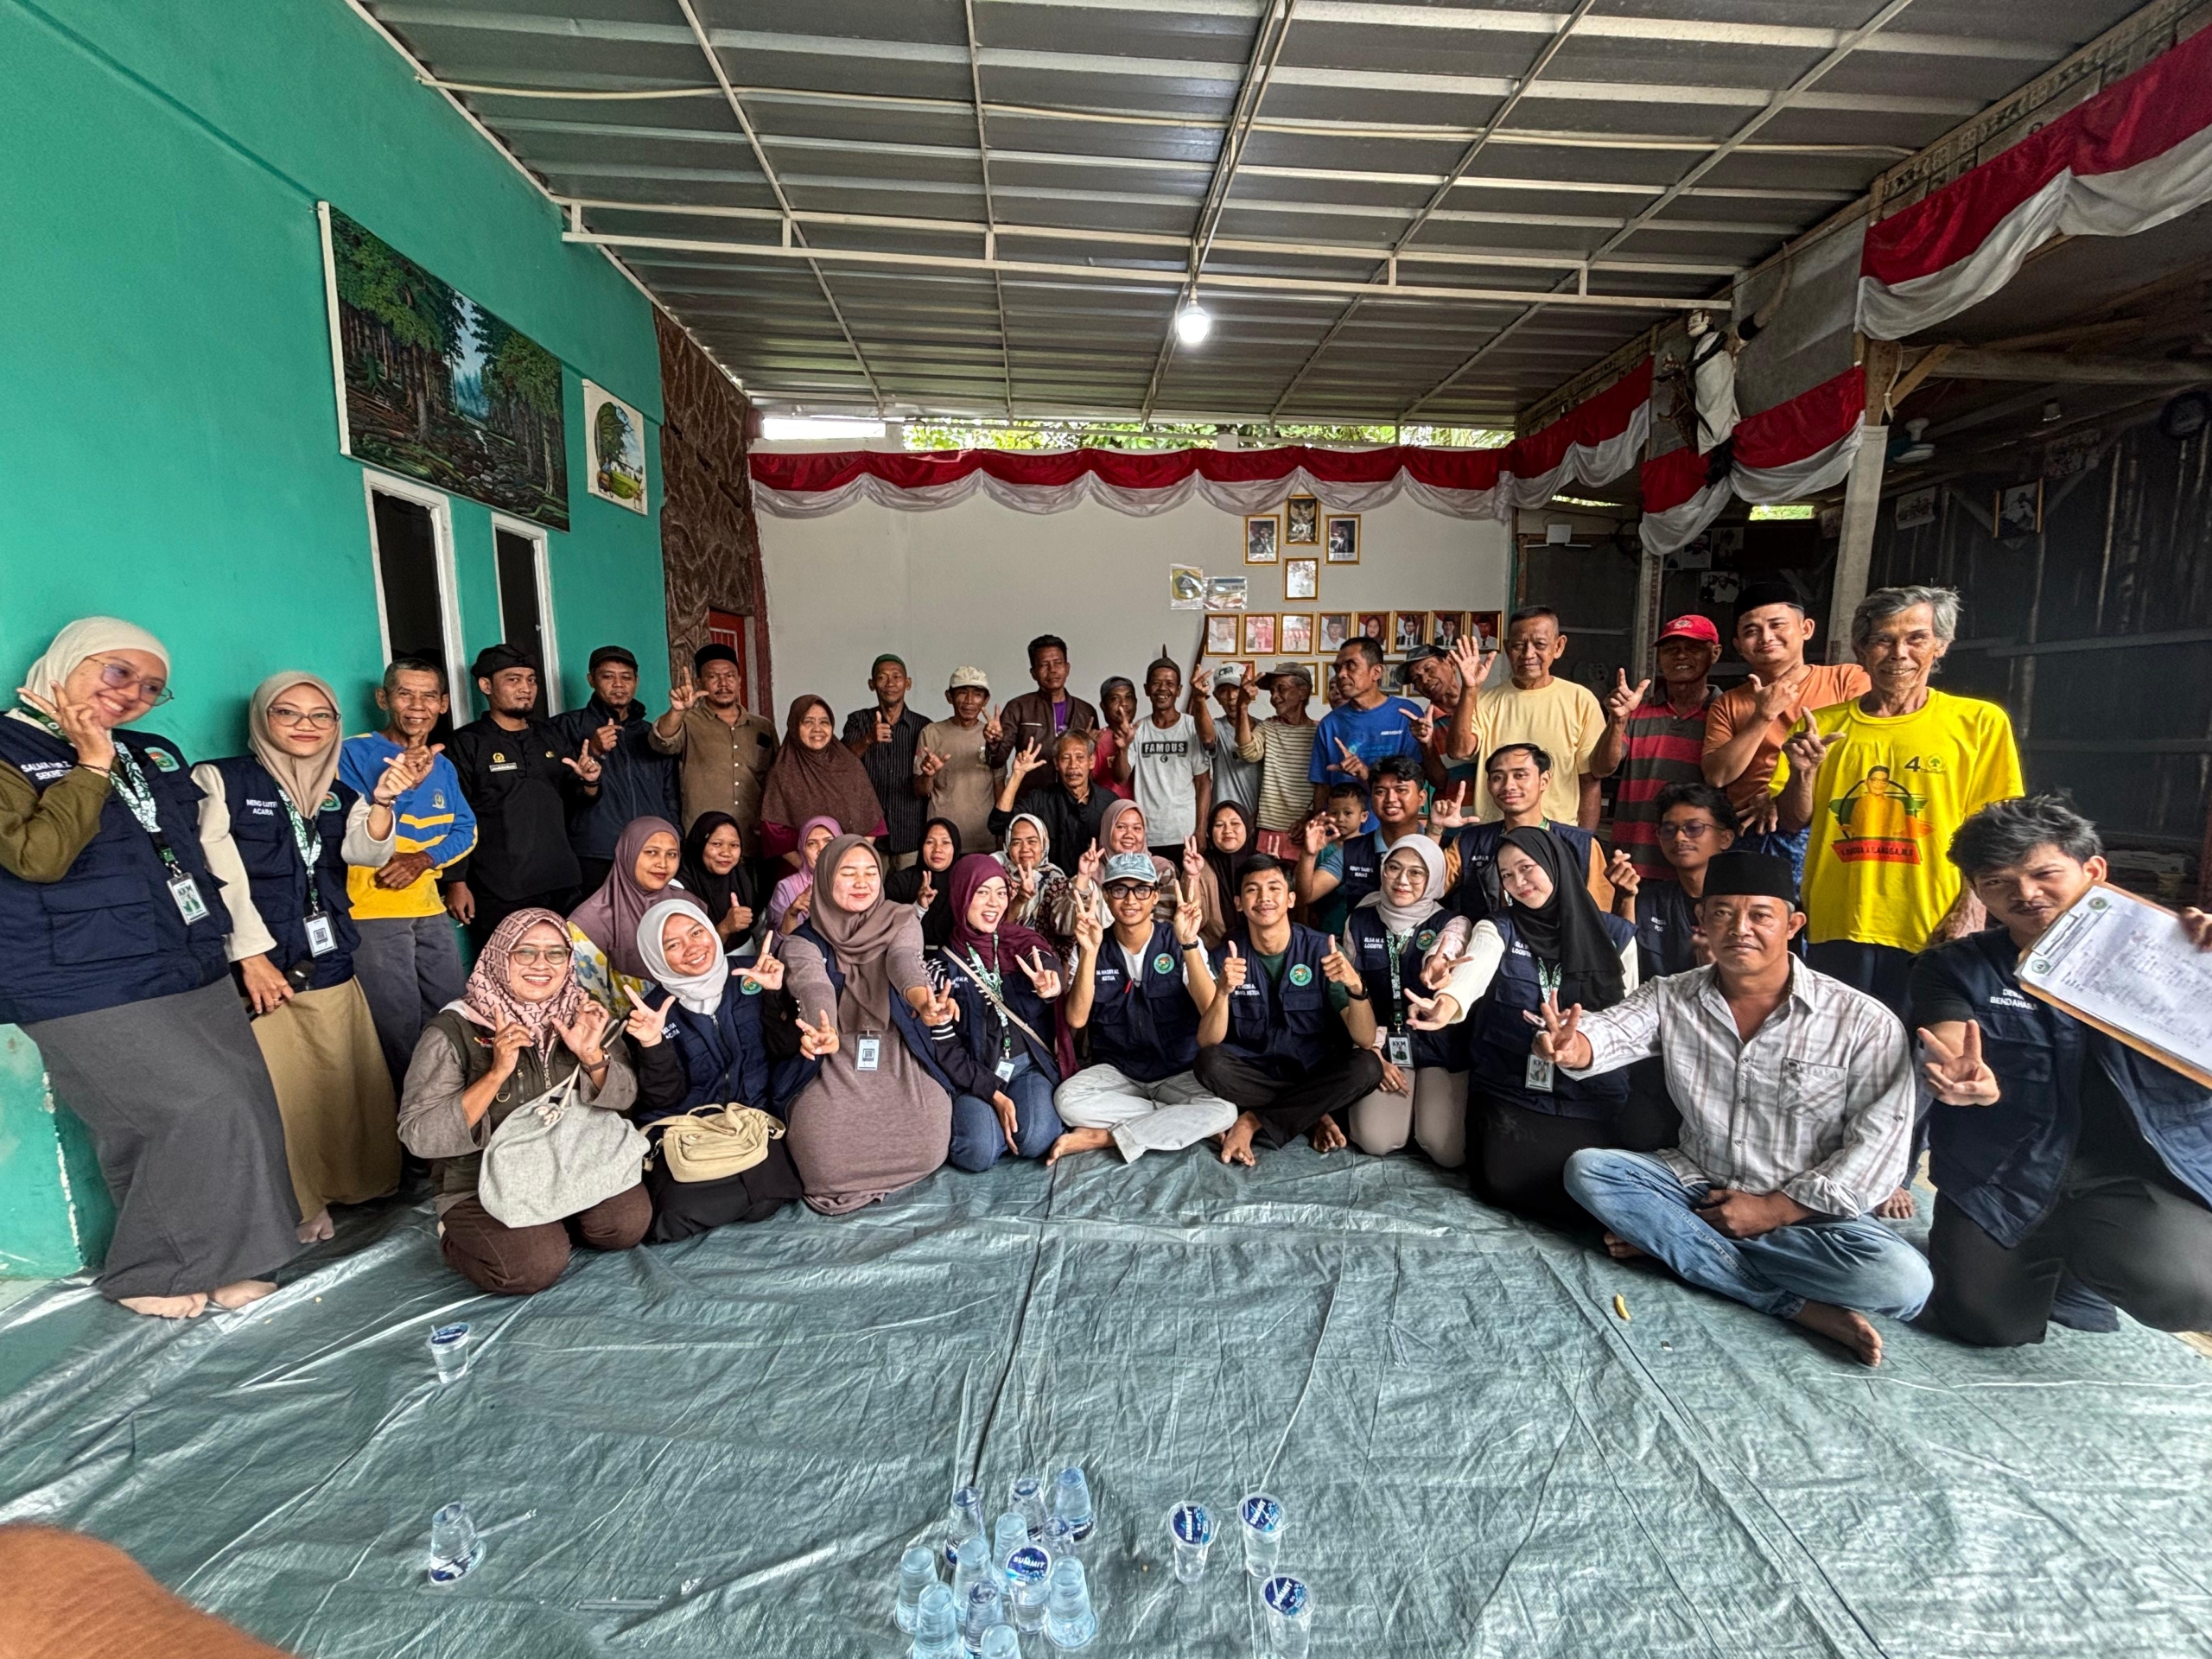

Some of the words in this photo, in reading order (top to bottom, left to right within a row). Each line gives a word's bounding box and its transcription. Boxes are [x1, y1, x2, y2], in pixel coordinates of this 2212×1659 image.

[1145, 743, 1185, 753] FAMOUS
[1904, 756, 1921, 772] 4
[1013, 1556, 1046, 1569] SUMMIT
